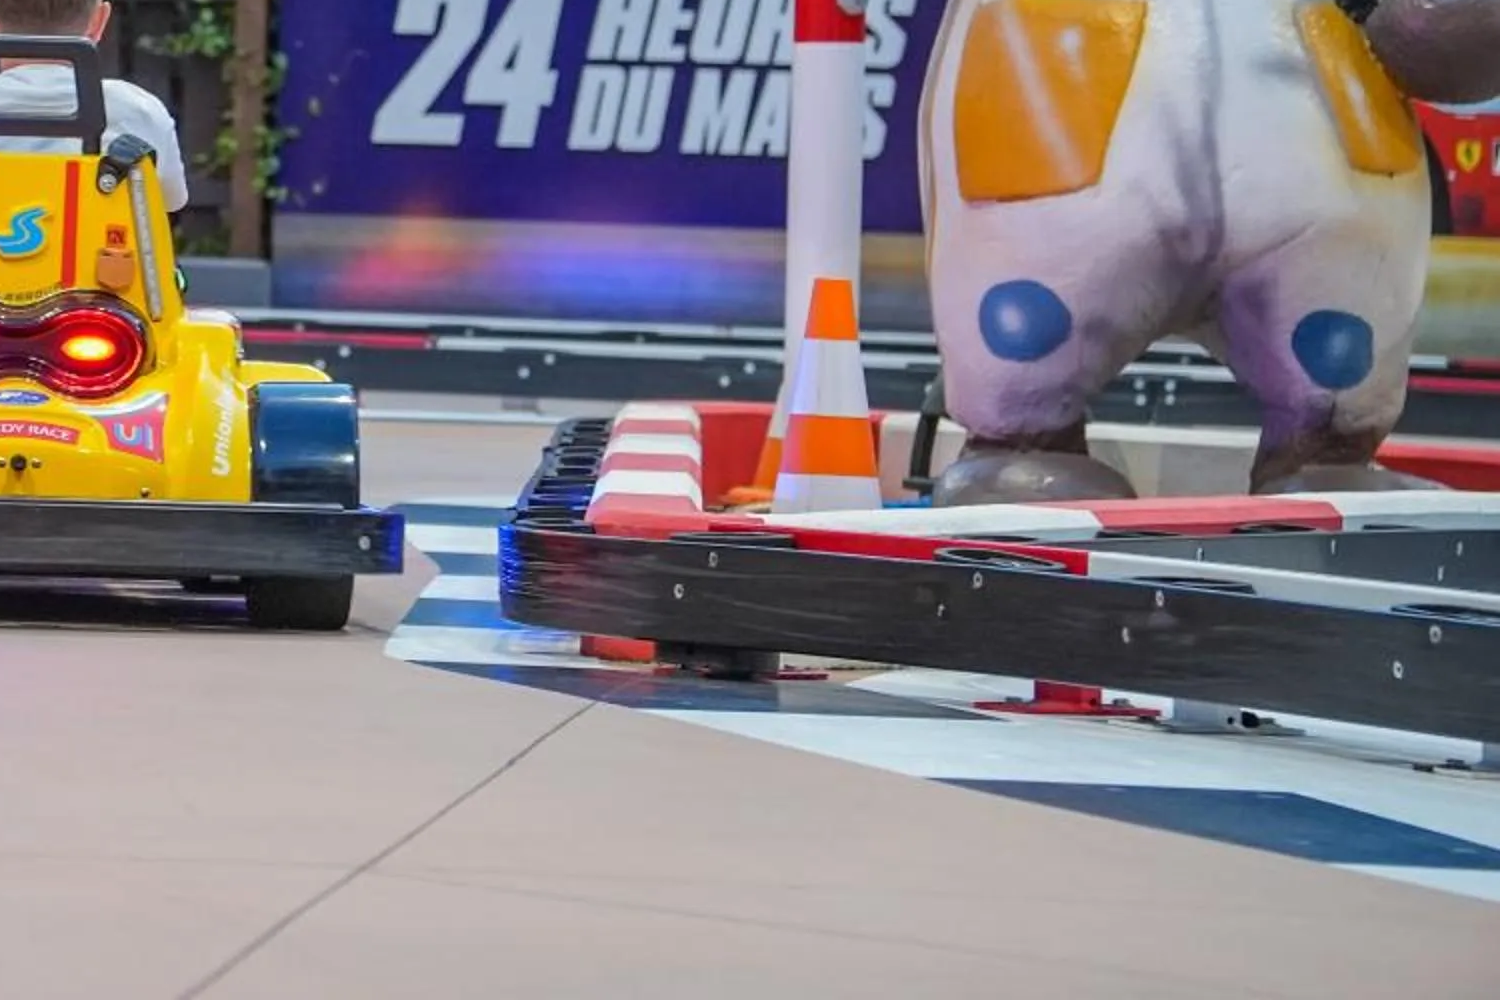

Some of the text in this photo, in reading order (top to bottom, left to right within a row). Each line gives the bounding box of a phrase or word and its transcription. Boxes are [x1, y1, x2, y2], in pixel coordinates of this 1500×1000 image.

[567, 64, 896, 161] DU MAS
[27, 424, 70, 441] RACE
